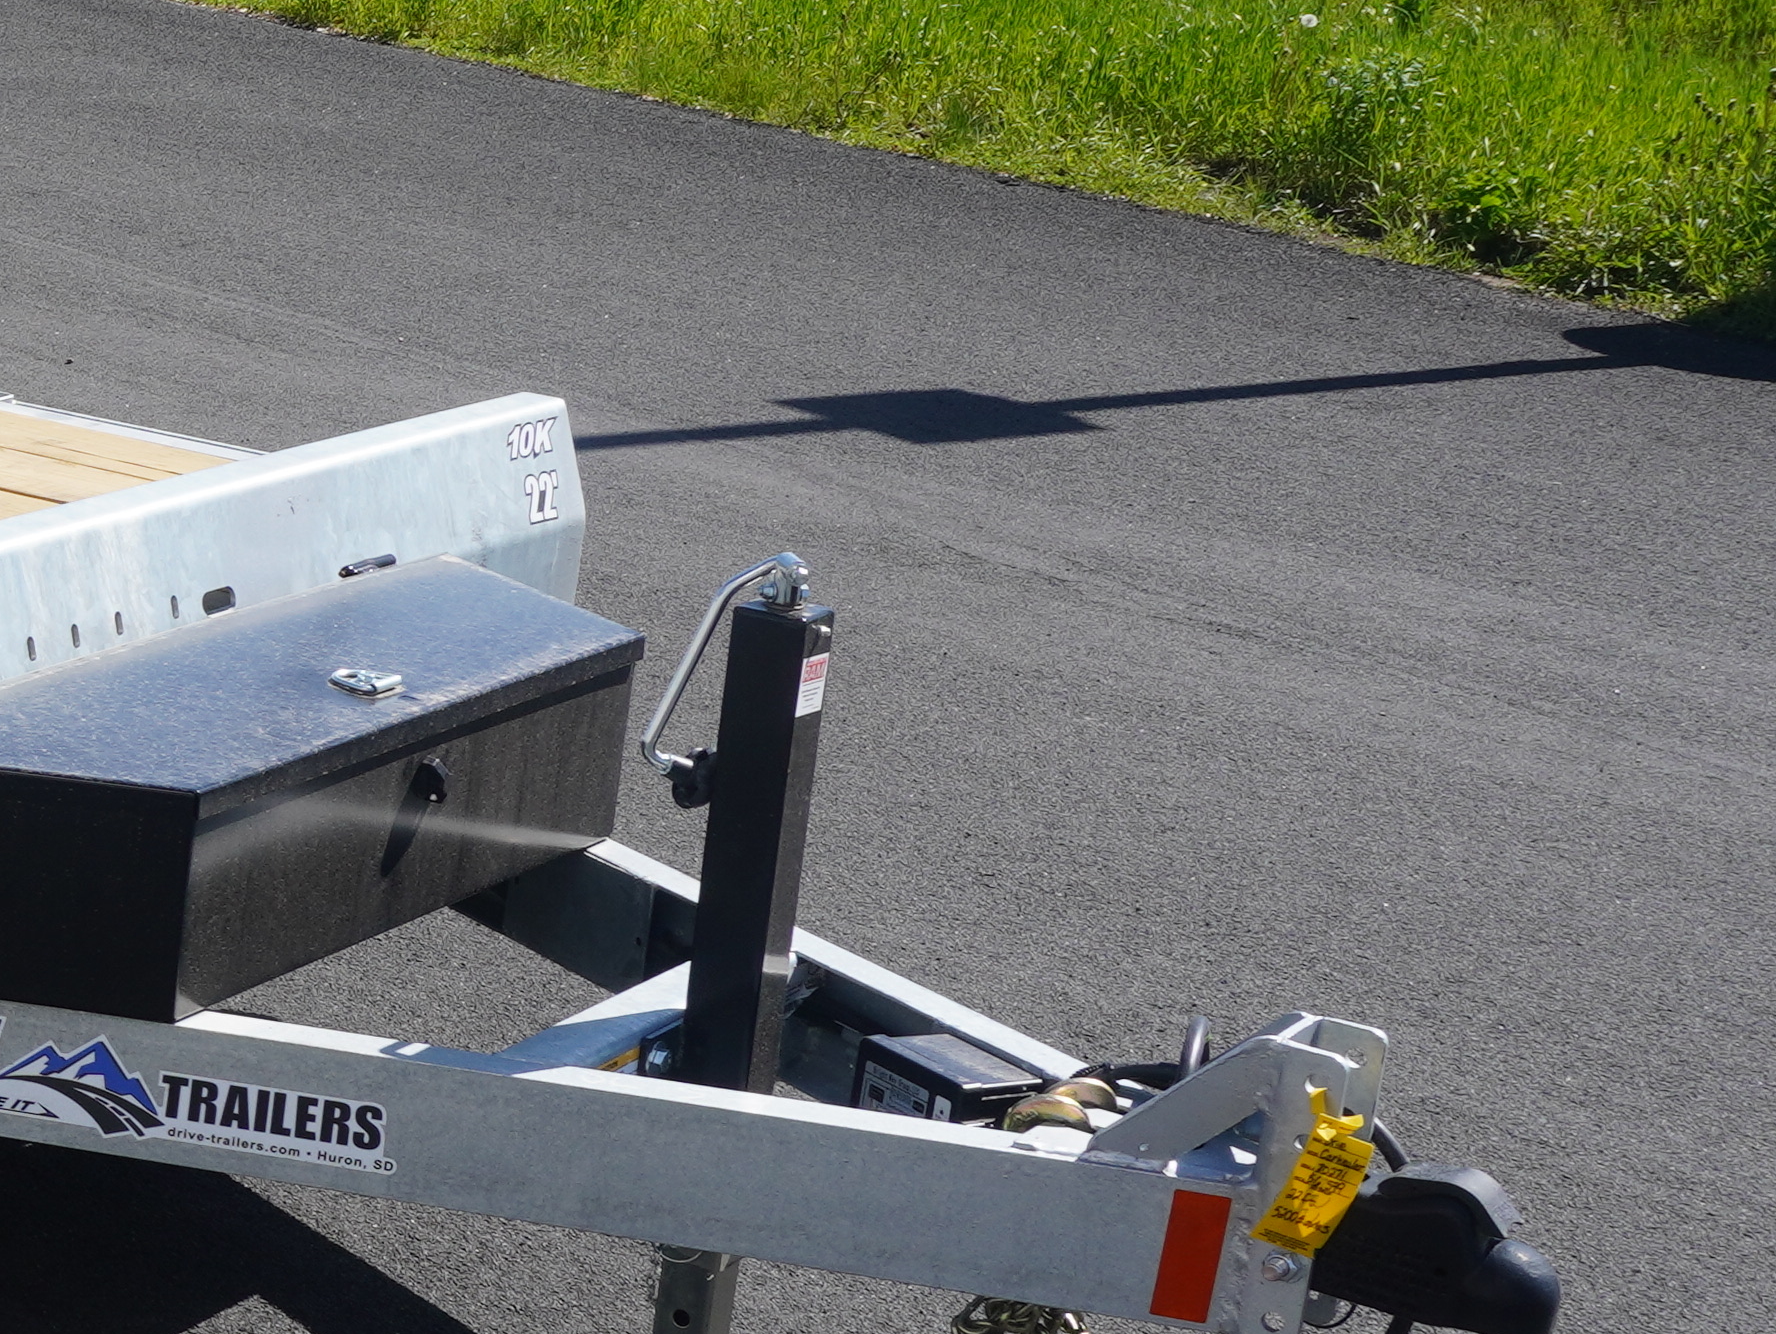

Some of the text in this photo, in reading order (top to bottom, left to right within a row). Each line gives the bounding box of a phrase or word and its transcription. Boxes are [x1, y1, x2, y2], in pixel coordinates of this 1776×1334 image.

[506, 416, 558, 461] 10K
[524, 469, 558, 525] 22'
[11, 1099, 35, 1111] IT
[162, 1074, 383, 1150] TRAILERS
[167, 1127, 394, 1172] drive-trailers.com Huron, SD
